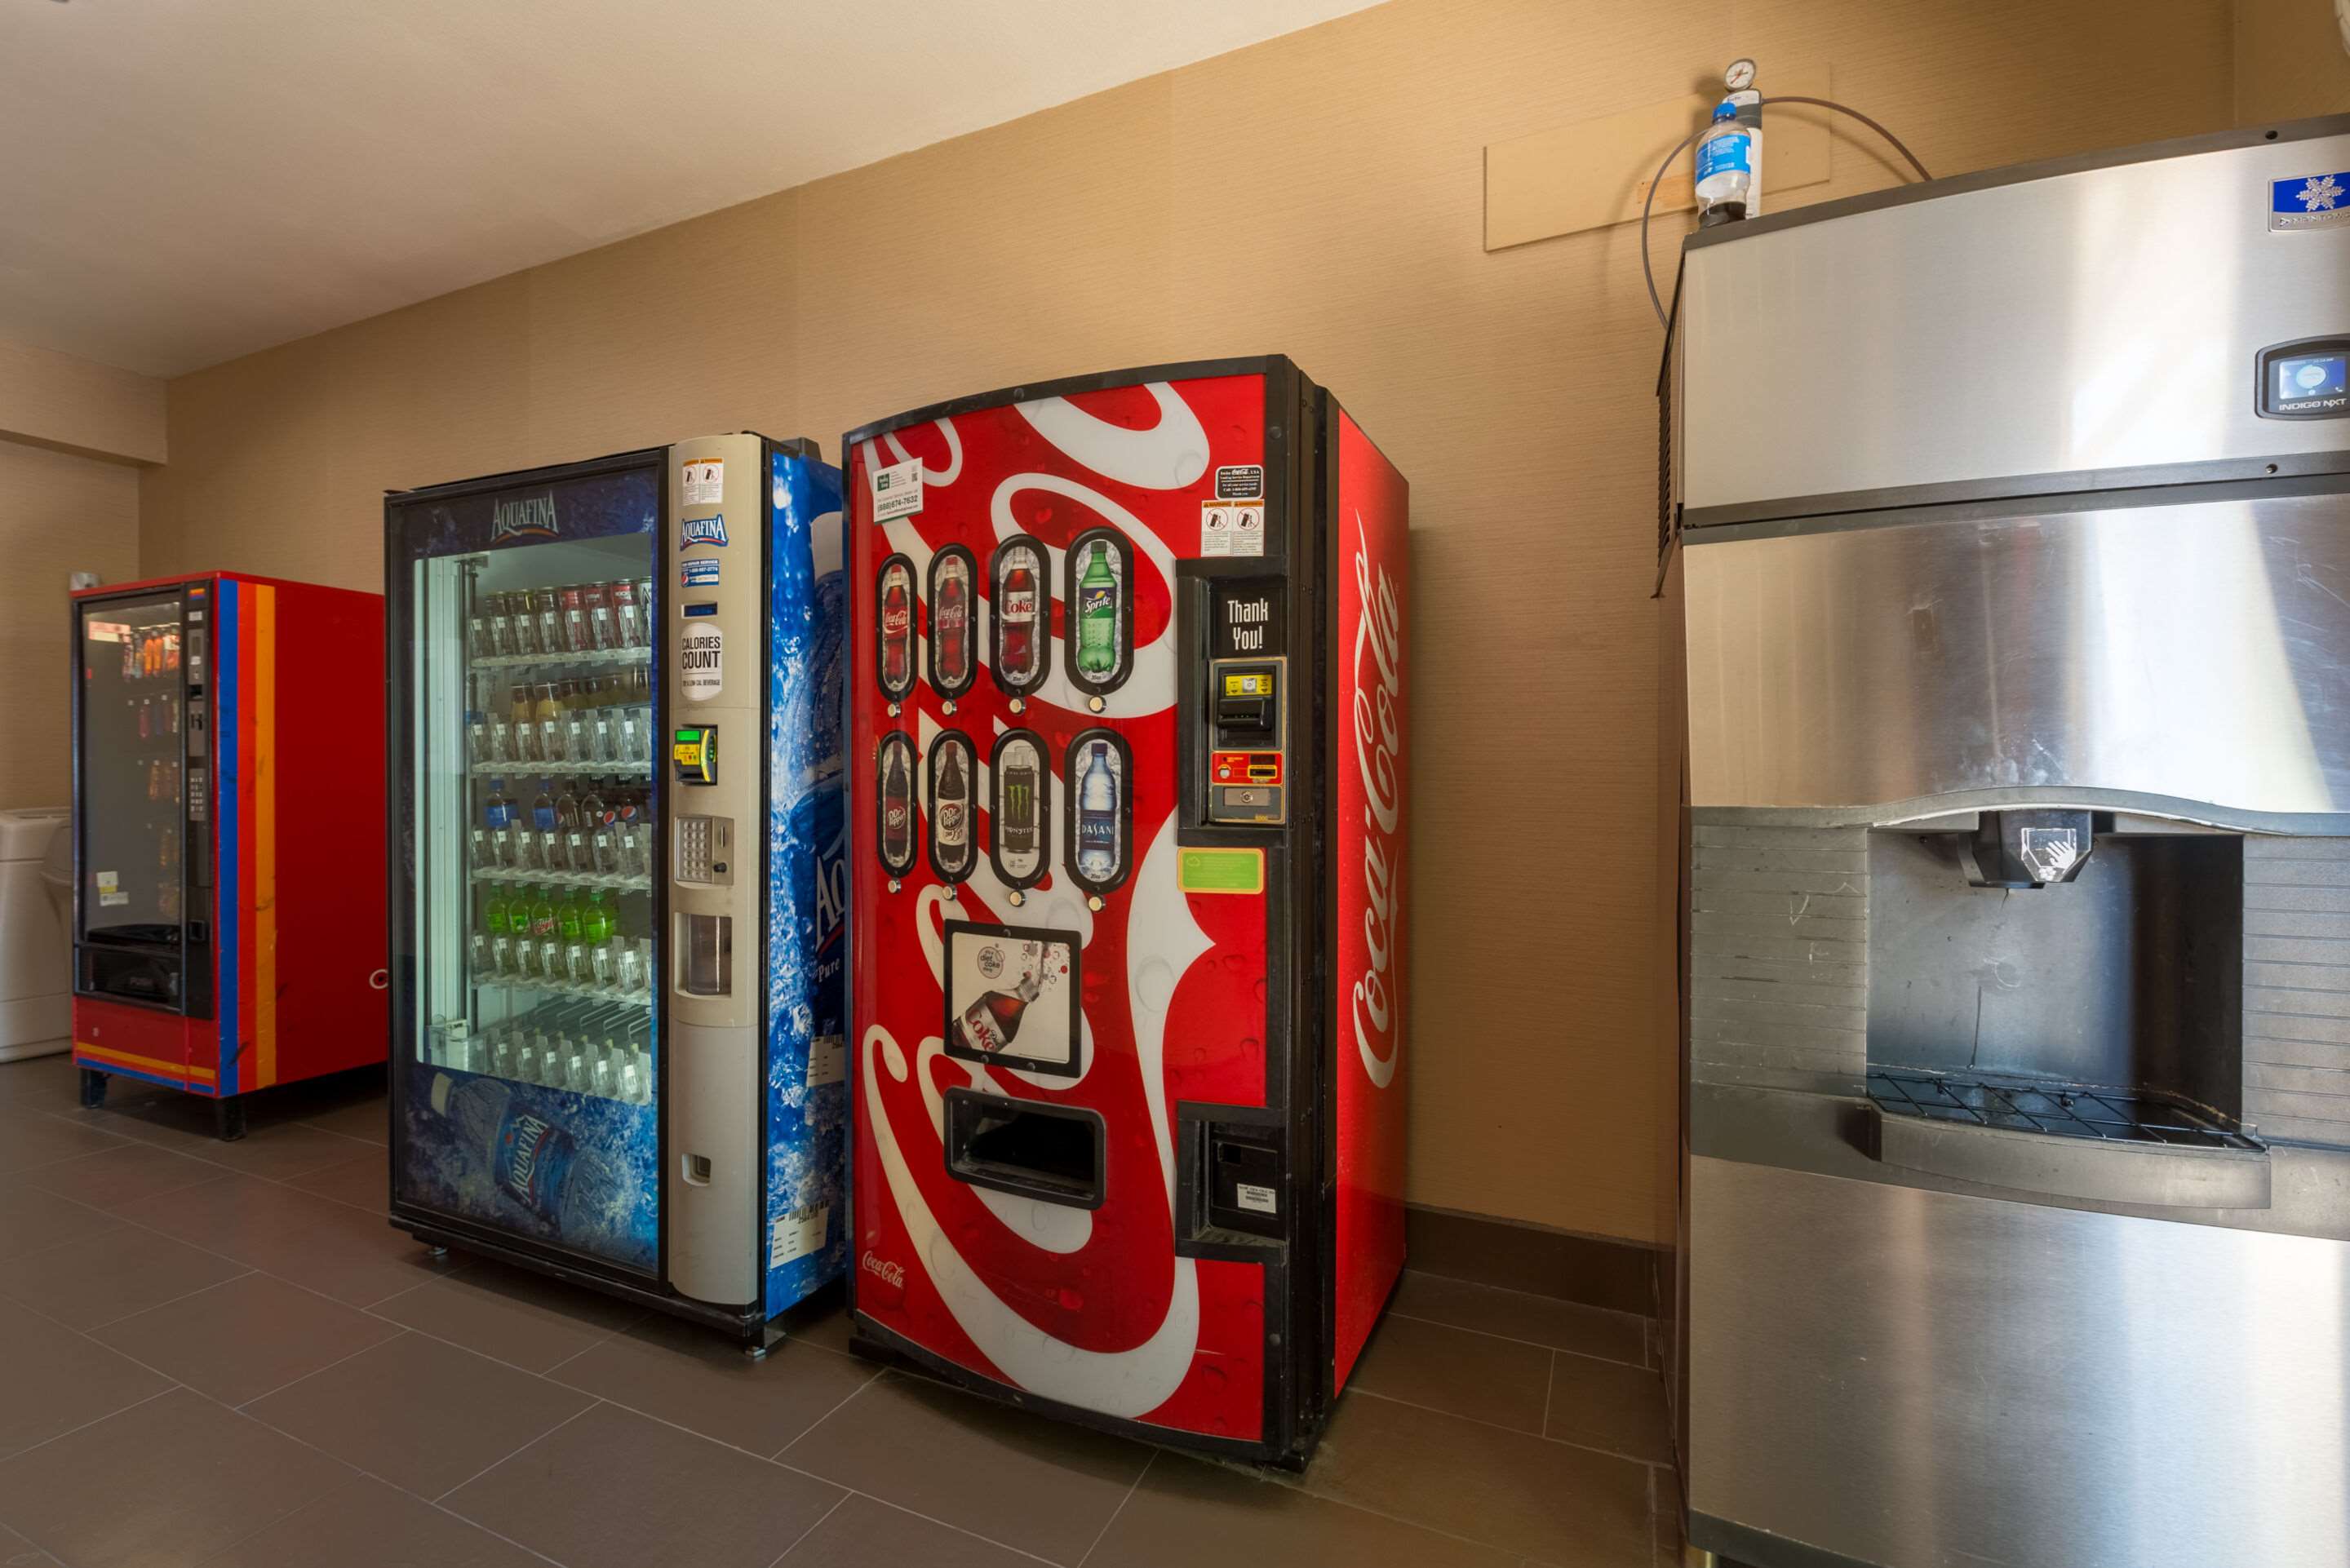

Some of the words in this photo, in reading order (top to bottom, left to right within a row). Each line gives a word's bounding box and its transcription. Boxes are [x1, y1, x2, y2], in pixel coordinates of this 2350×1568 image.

[2279, 401, 2321, 411] INDIGO
[2323, 397, 2348, 408] NXT
[490, 489, 560, 542] AQUAFINA
[681, 514, 727, 548] AQUAFINA
[1004, 600, 1032, 614] Coke
[1084, 596, 1111, 613] Sprite
[1227, 597, 1269, 623] Thank
[682, 636, 721, 650] CALORIES
[1233, 625, 1263, 650] You!
[682, 651, 721, 670] COUNT
[1353, 509, 1399, 1088] Coca-Cola
[1004, 826, 1033, 835] MONSTER
[1081, 822, 1114, 835] DASANI
[966, 1008, 996, 1052] Coke
[509, 1114, 548, 1206] AQUAFINA
[862, 1250, 906, 1289] Coca-Cola
